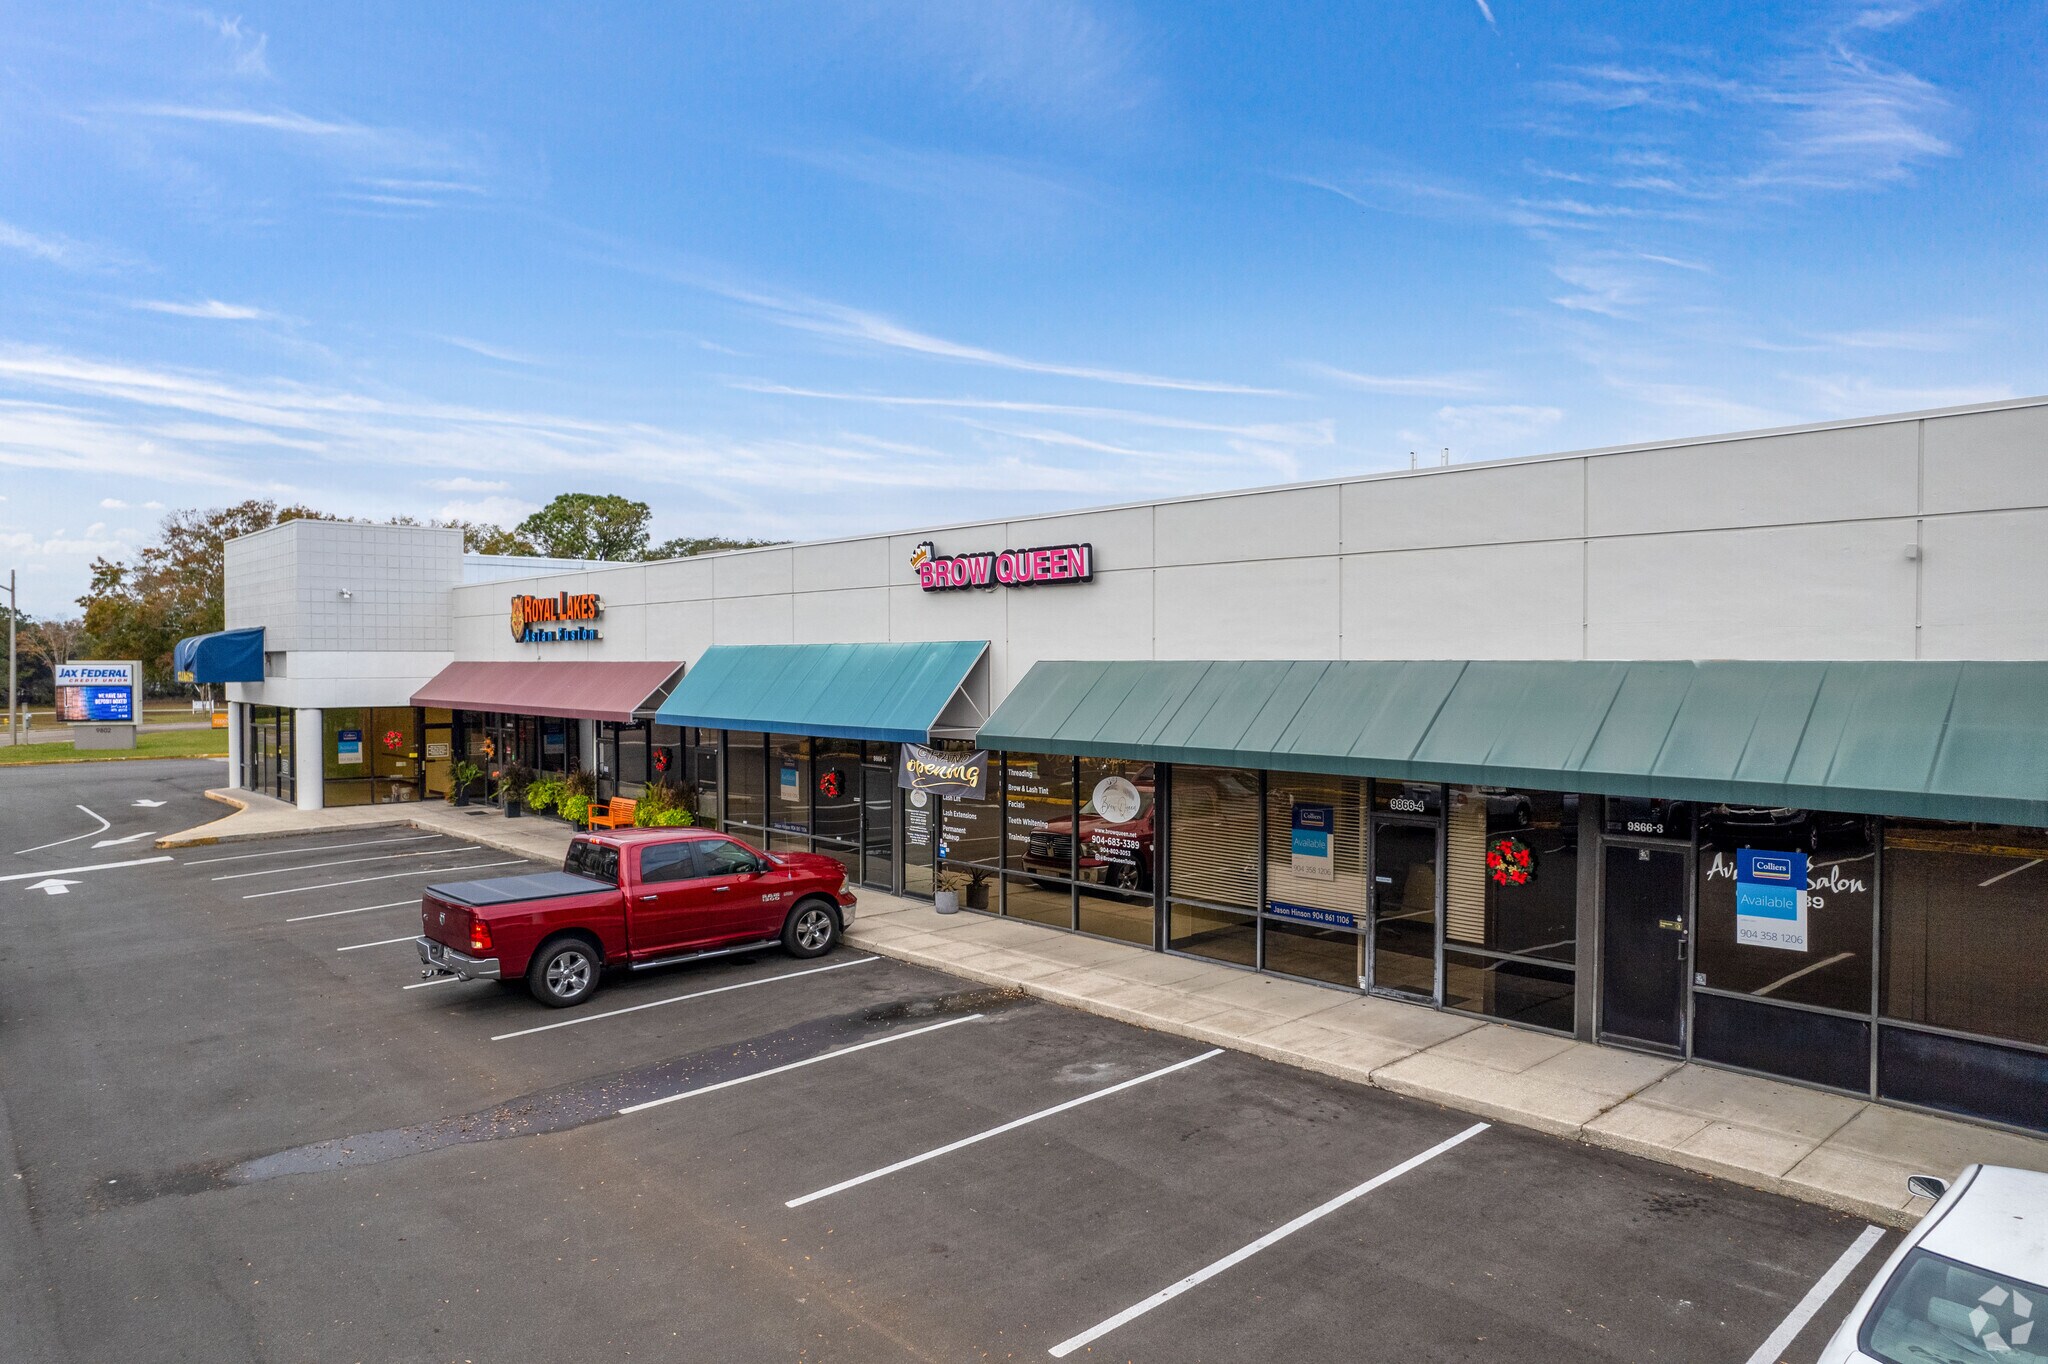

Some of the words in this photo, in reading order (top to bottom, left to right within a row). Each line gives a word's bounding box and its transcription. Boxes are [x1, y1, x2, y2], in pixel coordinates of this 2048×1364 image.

[920, 553, 993, 590] BROW
[996, 546, 1088, 584] QUEEN
[524, 595, 558, 623] ROYAL
[560, 591, 598, 620] LAKES
[525, 628, 554, 642] Asian
[558, 626, 596, 641] Fusion
[59, 668, 78, 678] JAX
[81, 668, 128, 678] FEDERAL
[906, 759, 980, 788] opening
[1008, 769, 1033, 779] Threading
[1008, 784, 1021, 792] Brow
[1026, 785, 1038, 794] Lash
[1038, 786, 1049, 795] Tint
[1008, 800, 1025, 809] Facials
[1390, 798, 1424, 812] 9866-4
[943, 809, 953, 817] Lash
[953, 810, 977, 820] Extensions
[1303, 812, 1321, 820] Colliers
[1008, 816, 1022, 825] Teeth
[1022, 818, 1049, 829] Whitening
[1627, 821, 1664, 833] 9866-3
[942, 824, 966, 834] Permanent
[942, 833, 960, 842] Makeup
[1008, 832, 1031, 843] Trainings
[1091, 835, 1140, 849] 904-683-3389
[1293, 838, 1326, 849] Available
[1317, 867, 1332, 876] 1206
[1756, 861, 1787, 872] Colliers
[1740, 894, 1794, 910] Available
[1273, 906, 1290, 915] Jason
[1291, 908, 1311, 918] Hinson
[1312, 911, 1324, 920] 904
[1324, 913, 1335, 922] 861
[1336, 915, 1350, 925] 1106
[1740, 929, 1758, 938] 904
[1760, 931, 1778, 941] 358
[1781, 933, 1803, 944] 1206
